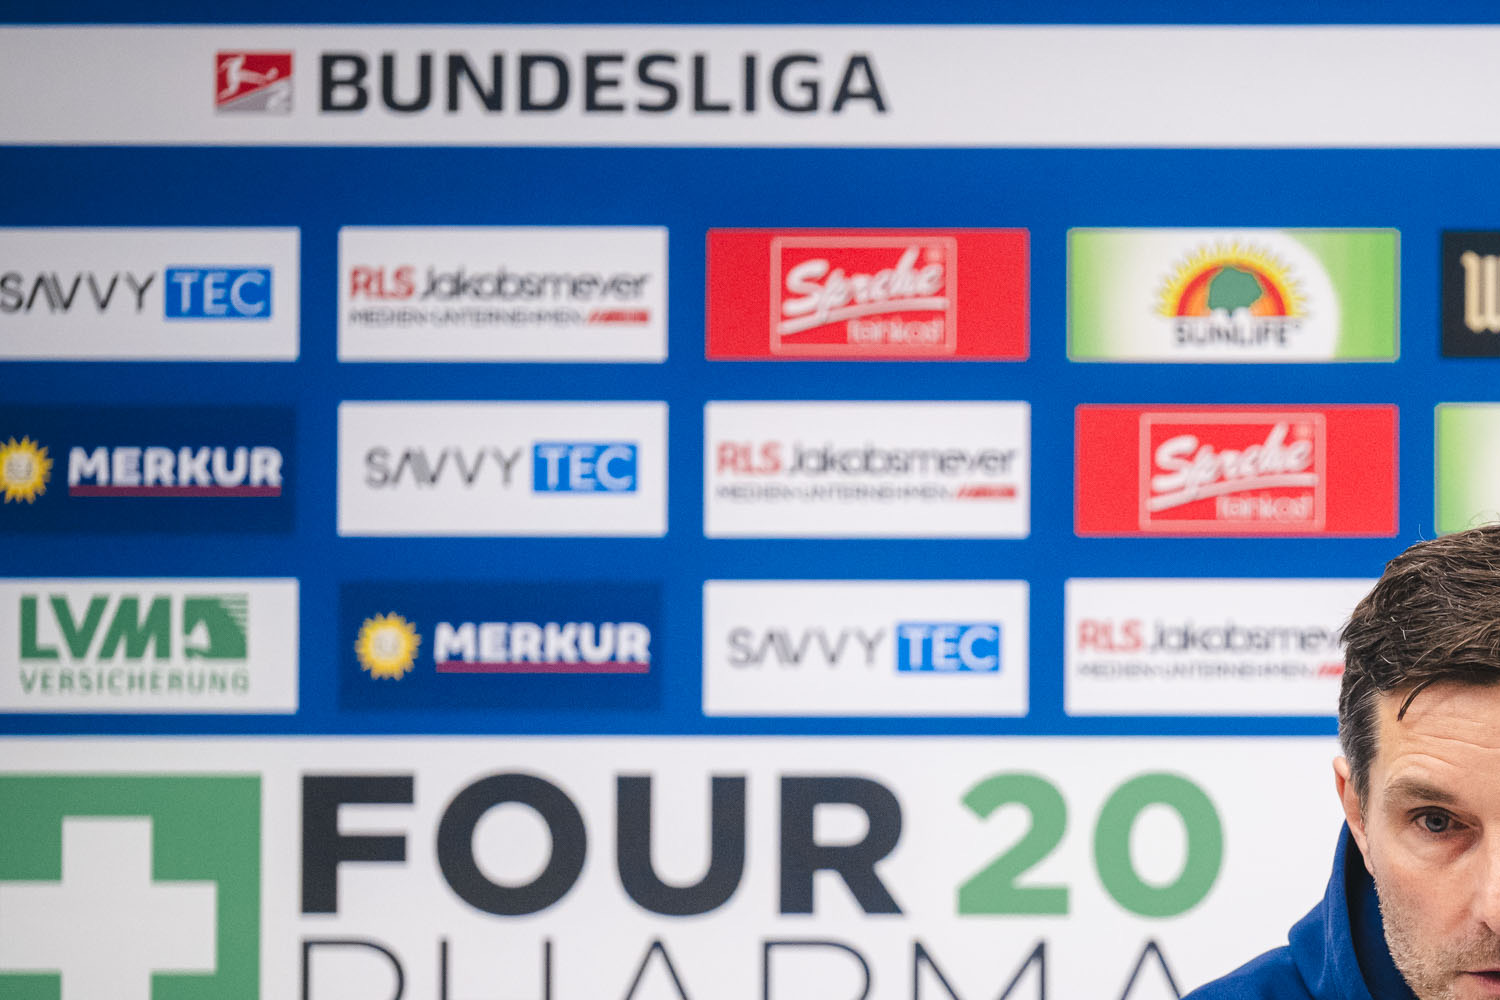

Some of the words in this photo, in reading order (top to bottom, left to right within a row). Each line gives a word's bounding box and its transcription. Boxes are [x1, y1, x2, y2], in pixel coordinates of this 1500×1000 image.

[319, 52, 887, 114] BUNDESLIGA
[173, 271, 267, 316] TEC
[350, 266, 415, 300] RLS
[68, 447, 283, 486] MERKUR
[364, 446, 522, 489] SAVVY
[540, 446, 632, 491] TEC
[717, 441, 783, 476] RLS
[19, 595, 171, 661] LVM
[434, 622, 650, 662] MERKUR
[727, 627, 885, 669] SAVVY
[900, 626, 999, 671] TEC
[1077, 619, 1144, 653] RLS
[19, 668, 249, 695] VERSICHERUNG
[299, 771, 904, 918] FOUR
[956, 771, 1225, 920] 20
